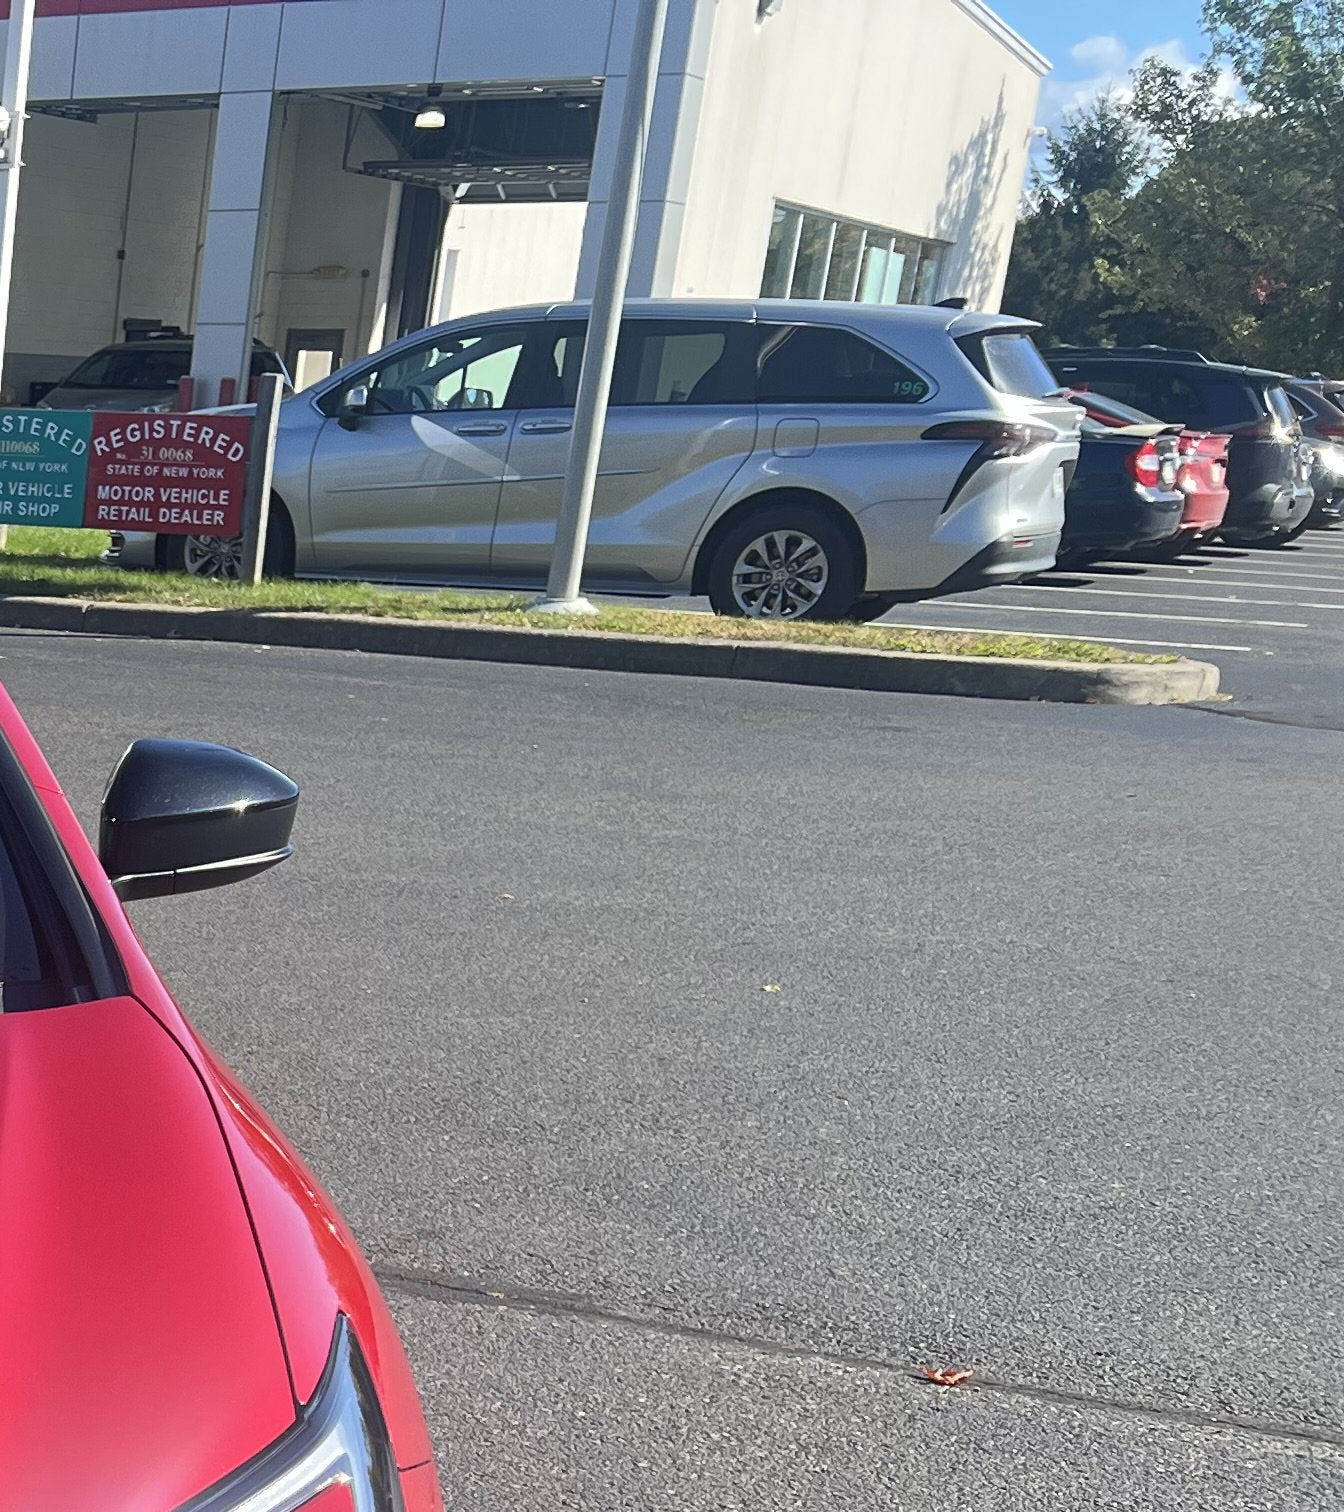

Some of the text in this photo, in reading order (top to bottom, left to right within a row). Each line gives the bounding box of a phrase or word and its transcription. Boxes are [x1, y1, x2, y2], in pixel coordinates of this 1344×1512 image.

[894, 381, 925, 395] 196
[93, 420, 244, 462] REGISTERED
[39, 462, 68, 473] YORK
[106, 464, 224, 479] STATE OF NEW YORK
[8, 481, 73, 498] VEHICLE
[97, 485, 230, 505] MOTOR VEHICLE
[17, 501, 60, 517] SHOP
[97, 505, 225, 526] RETAIL DEALER
